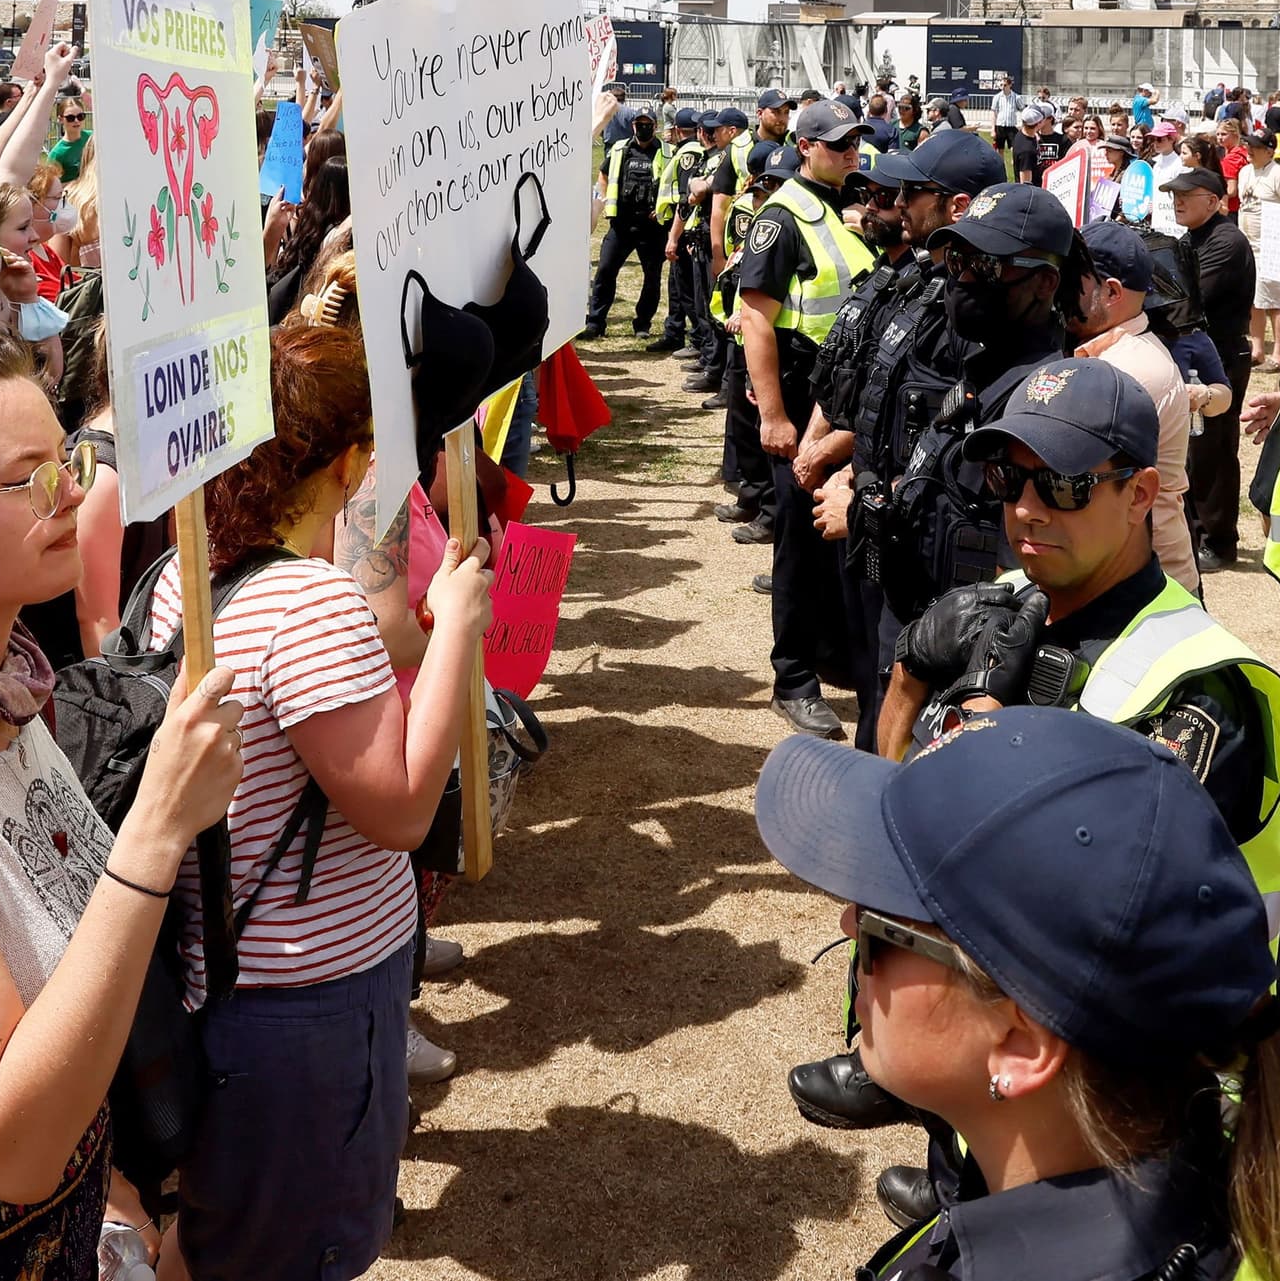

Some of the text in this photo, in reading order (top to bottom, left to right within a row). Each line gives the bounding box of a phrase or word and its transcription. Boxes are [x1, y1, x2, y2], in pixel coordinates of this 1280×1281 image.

[373, 37, 447, 125] You're
[457, 29, 531, 84] never
[540, 15, 585, 89] gonna
[377, 75, 584, 197] win on us, our bodys
[376, 210, 404, 271] our
[478, 154, 513, 194] our
[519, 128, 574, 187] rights.
[145, 335, 249, 418] LOIN DE NOS
[167, 401, 236, 477] OVAIRES
